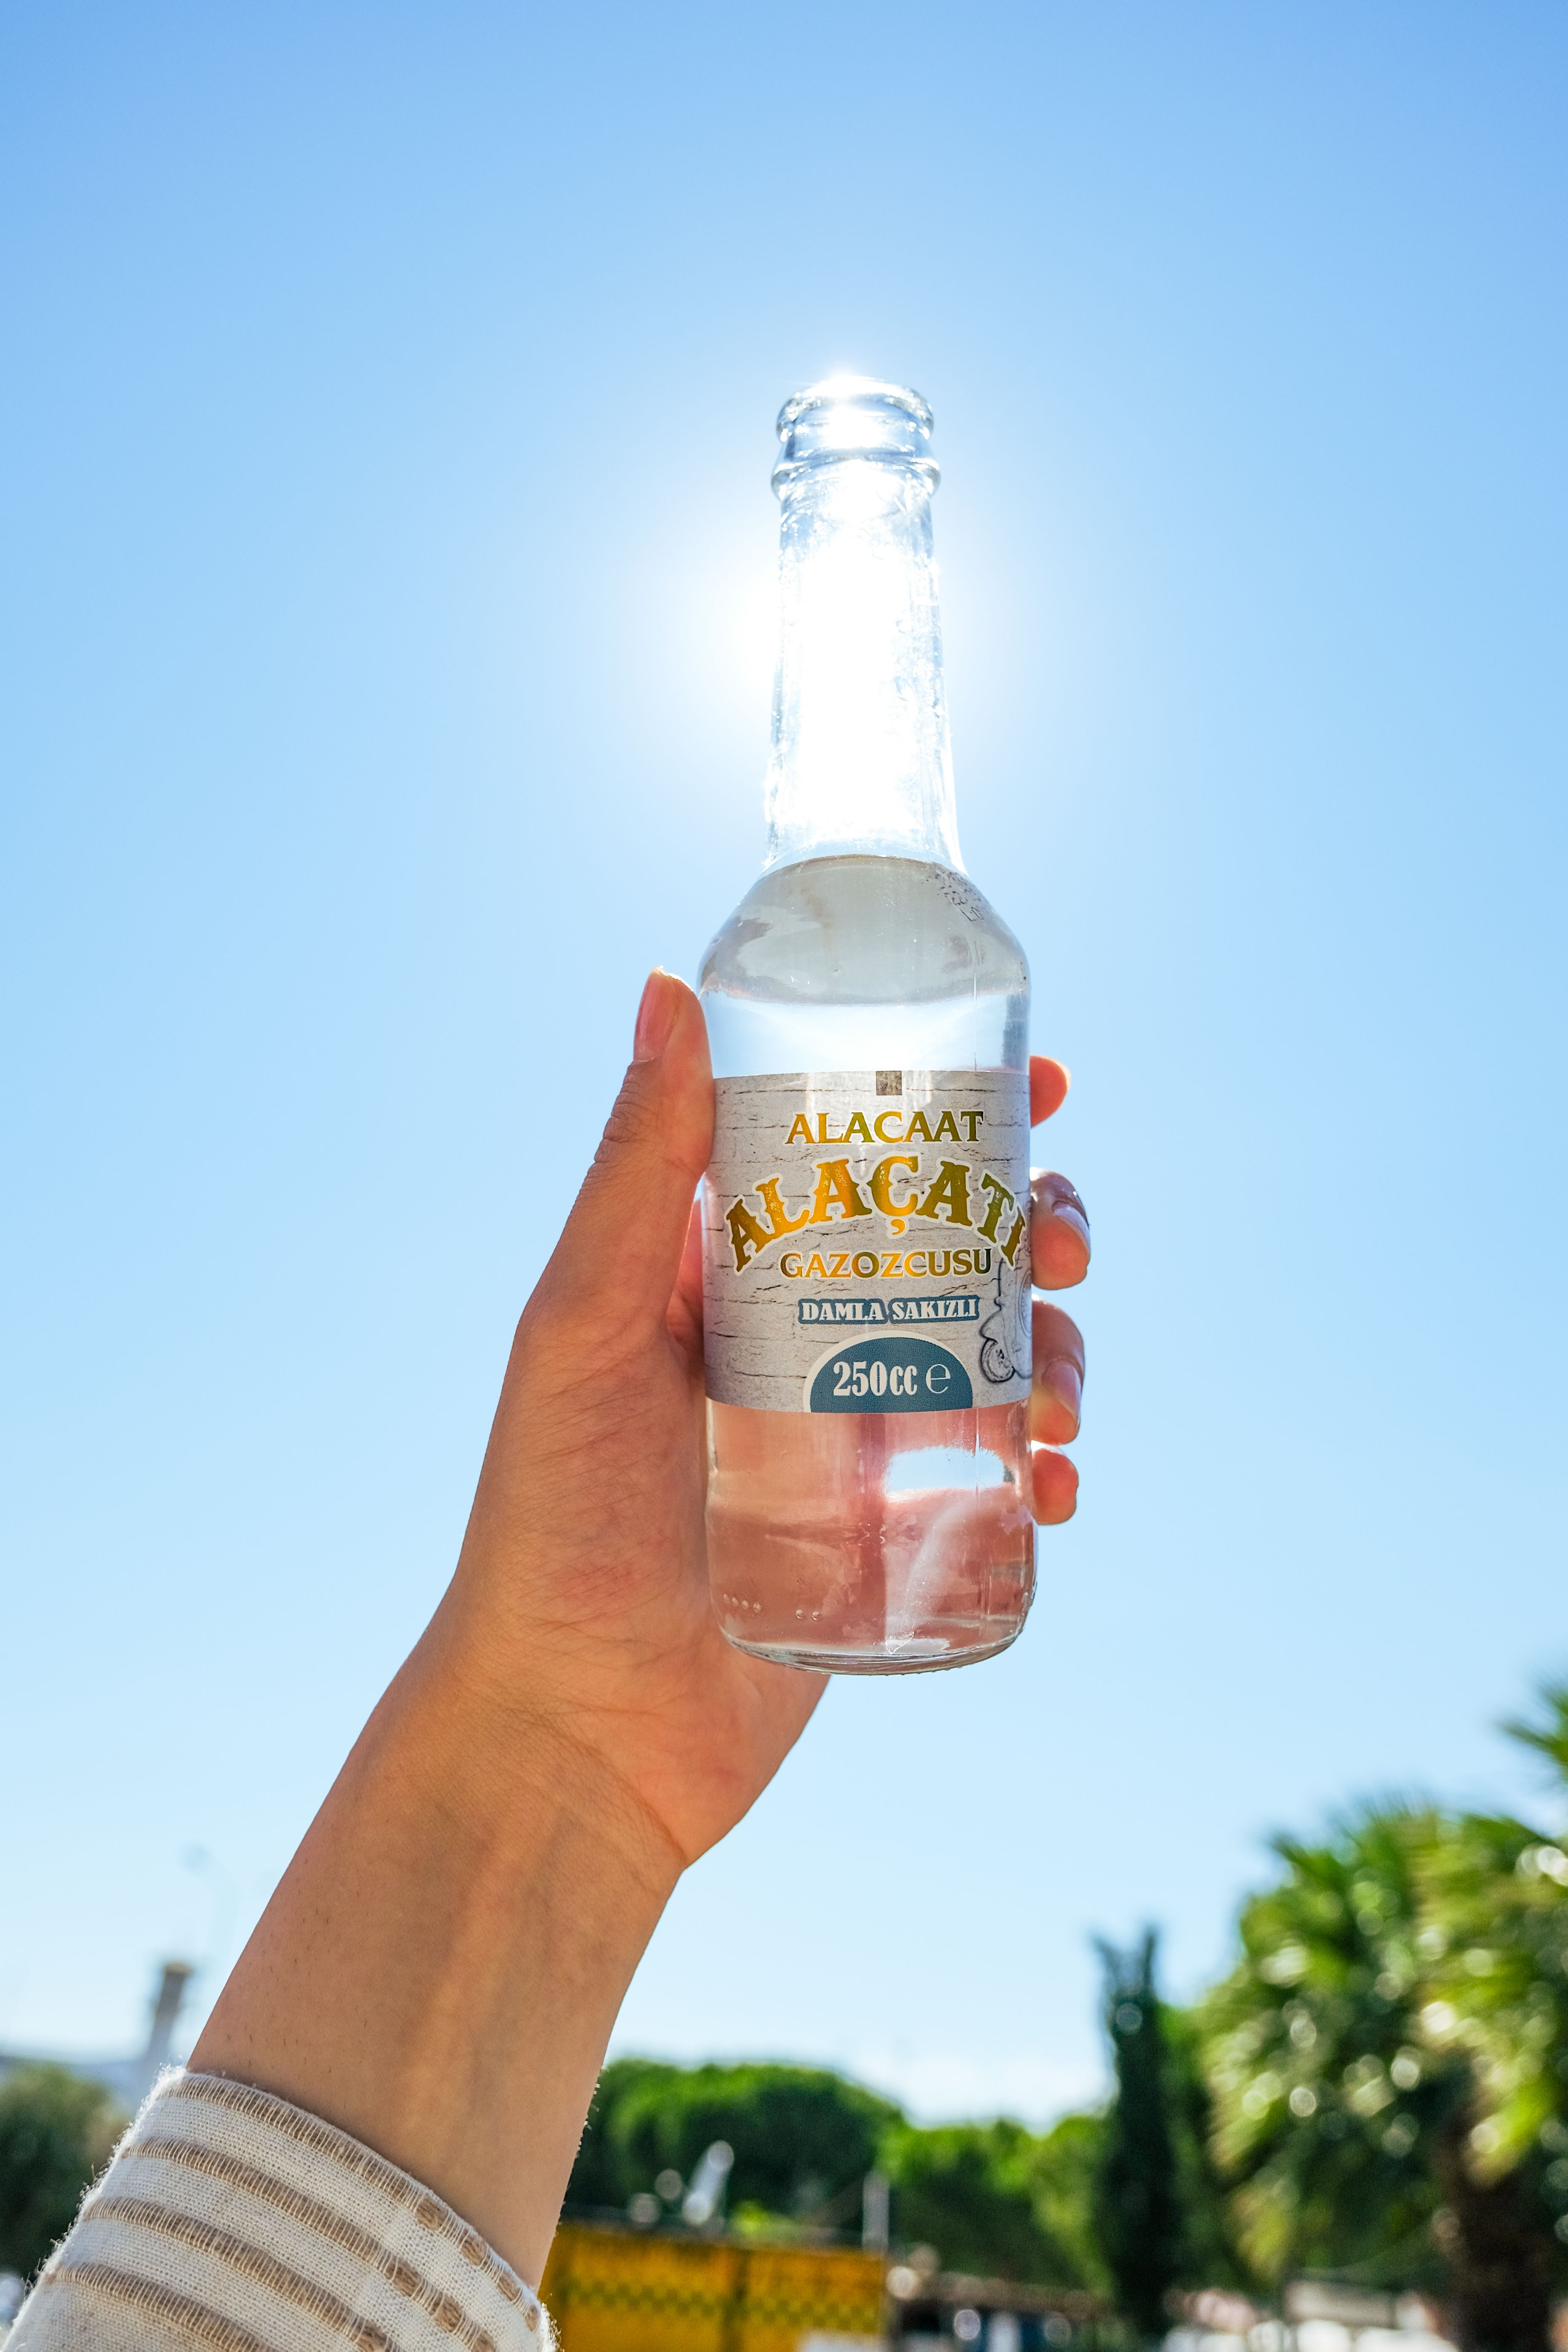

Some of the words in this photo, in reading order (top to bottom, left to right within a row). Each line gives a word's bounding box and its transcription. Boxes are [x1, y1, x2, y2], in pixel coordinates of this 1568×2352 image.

[785, 1111, 984, 1144] ALACAAT
[780, 1248, 992, 1278] GAZOZCUSU
[801, 1302, 885, 1321] DAMLA
[892, 1299, 977, 1320] SAKIZLI
